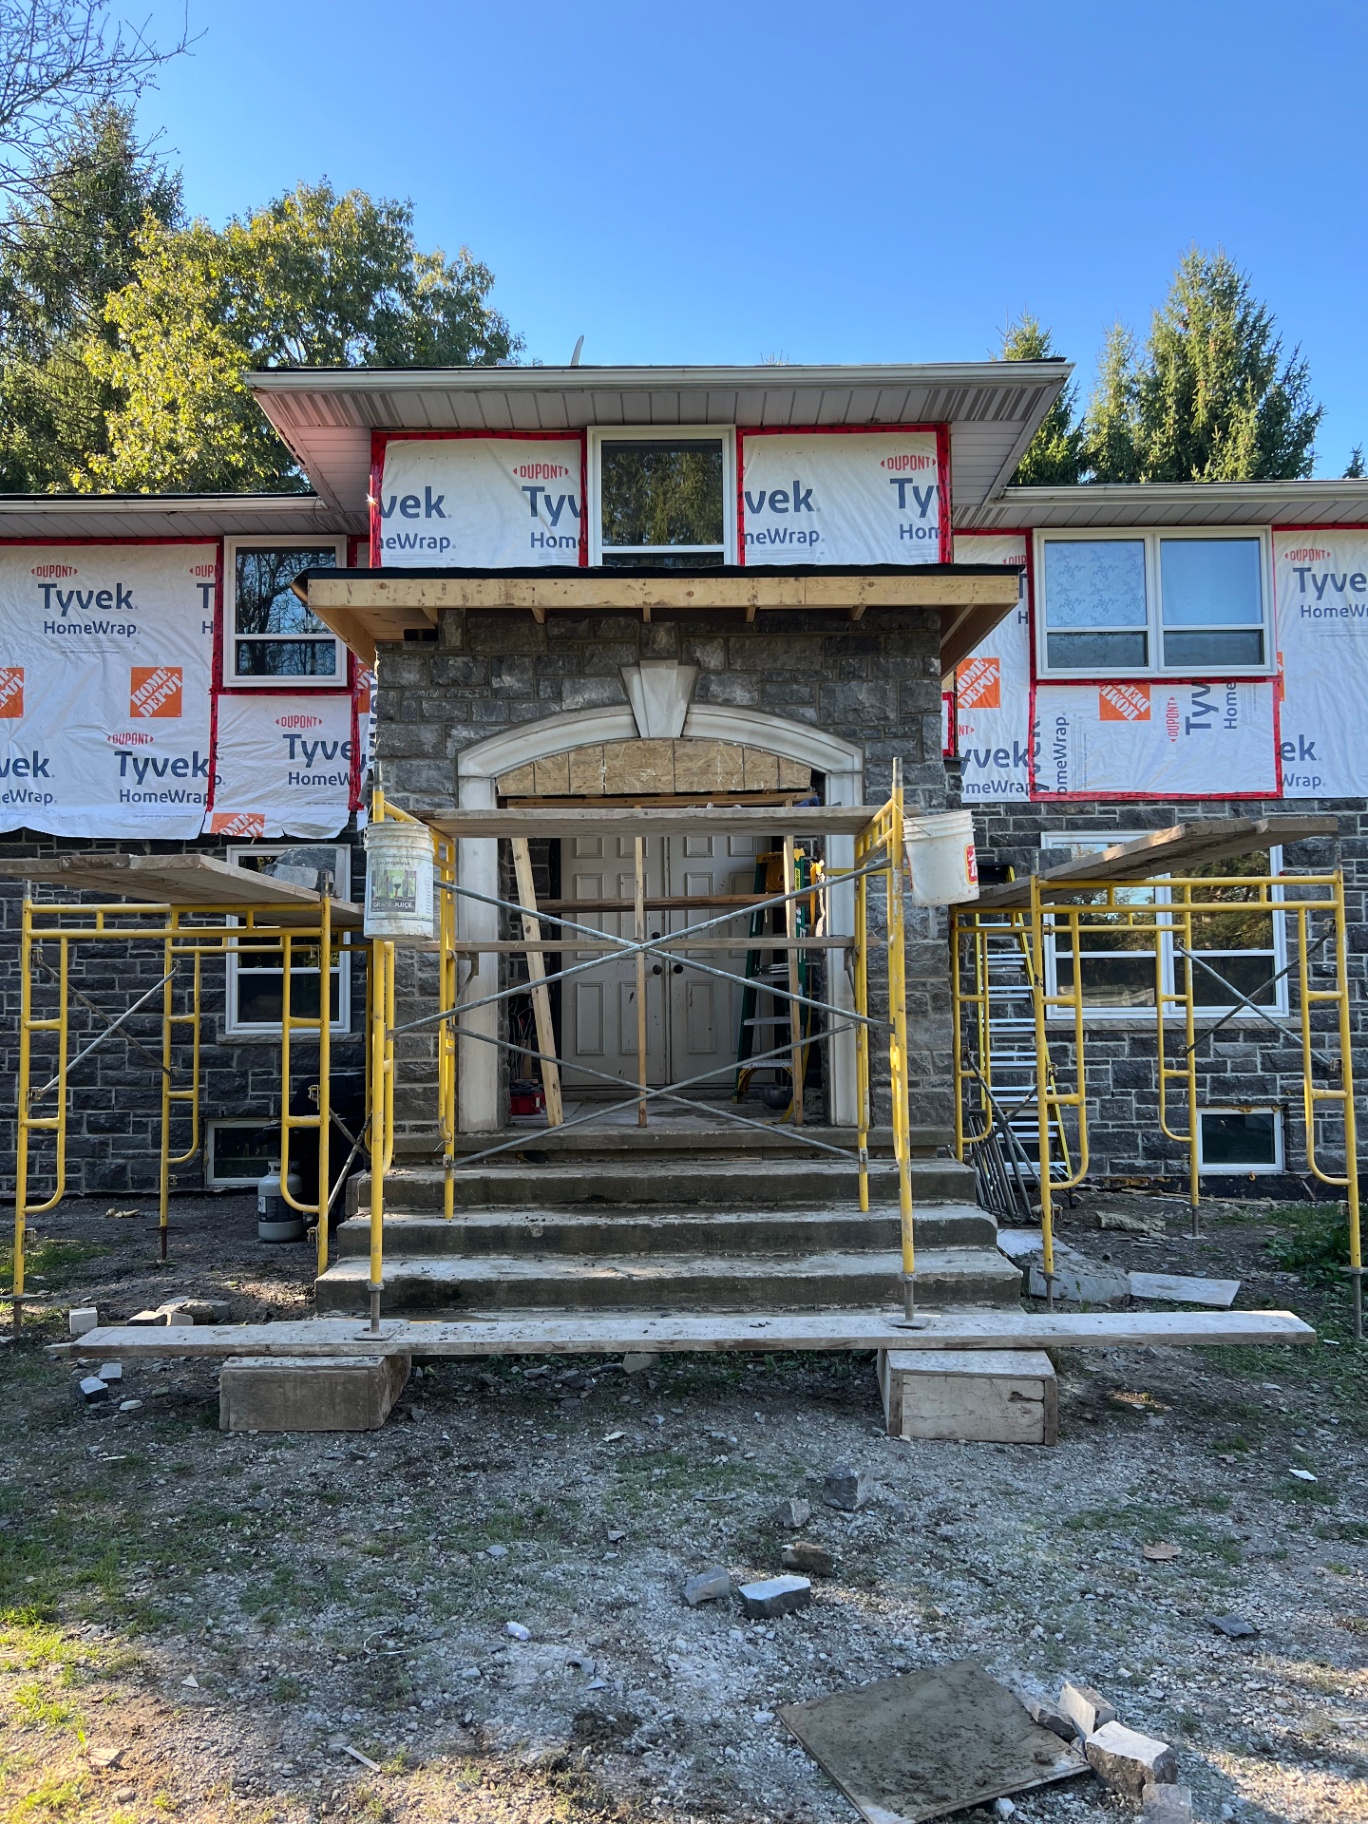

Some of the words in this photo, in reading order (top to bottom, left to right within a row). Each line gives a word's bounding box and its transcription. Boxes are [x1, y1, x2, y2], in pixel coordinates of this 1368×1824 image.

[520, 463, 563, 480] DUPONT
[887, 455, 930, 471] DUPONT
[745, 480, 815, 514] vek
[890, 477, 940, 518] Ty
[531, 532, 580, 549] Hom
[1290, 549, 1325, 561] DUPONT
[36, 565, 73, 578] DUPONT
[195, 564, 216, 578] DUP
[1293, 567, 1367, 600] Tyve
[38, 582, 133, 617] Tyvek
[44, 621, 137, 638] HomeWrap
[130, 667, 171, 706] HOME
[138, 673, 183, 717] DEPOT
[281, 715, 317, 729] DUPONT
[1166, 702, 1179, 736] DUPONT
[112, 732, 149, 745] DUPONT
[114, 750, 209, 785] Tyvek
[0, 789, 53, 806] eWrap
